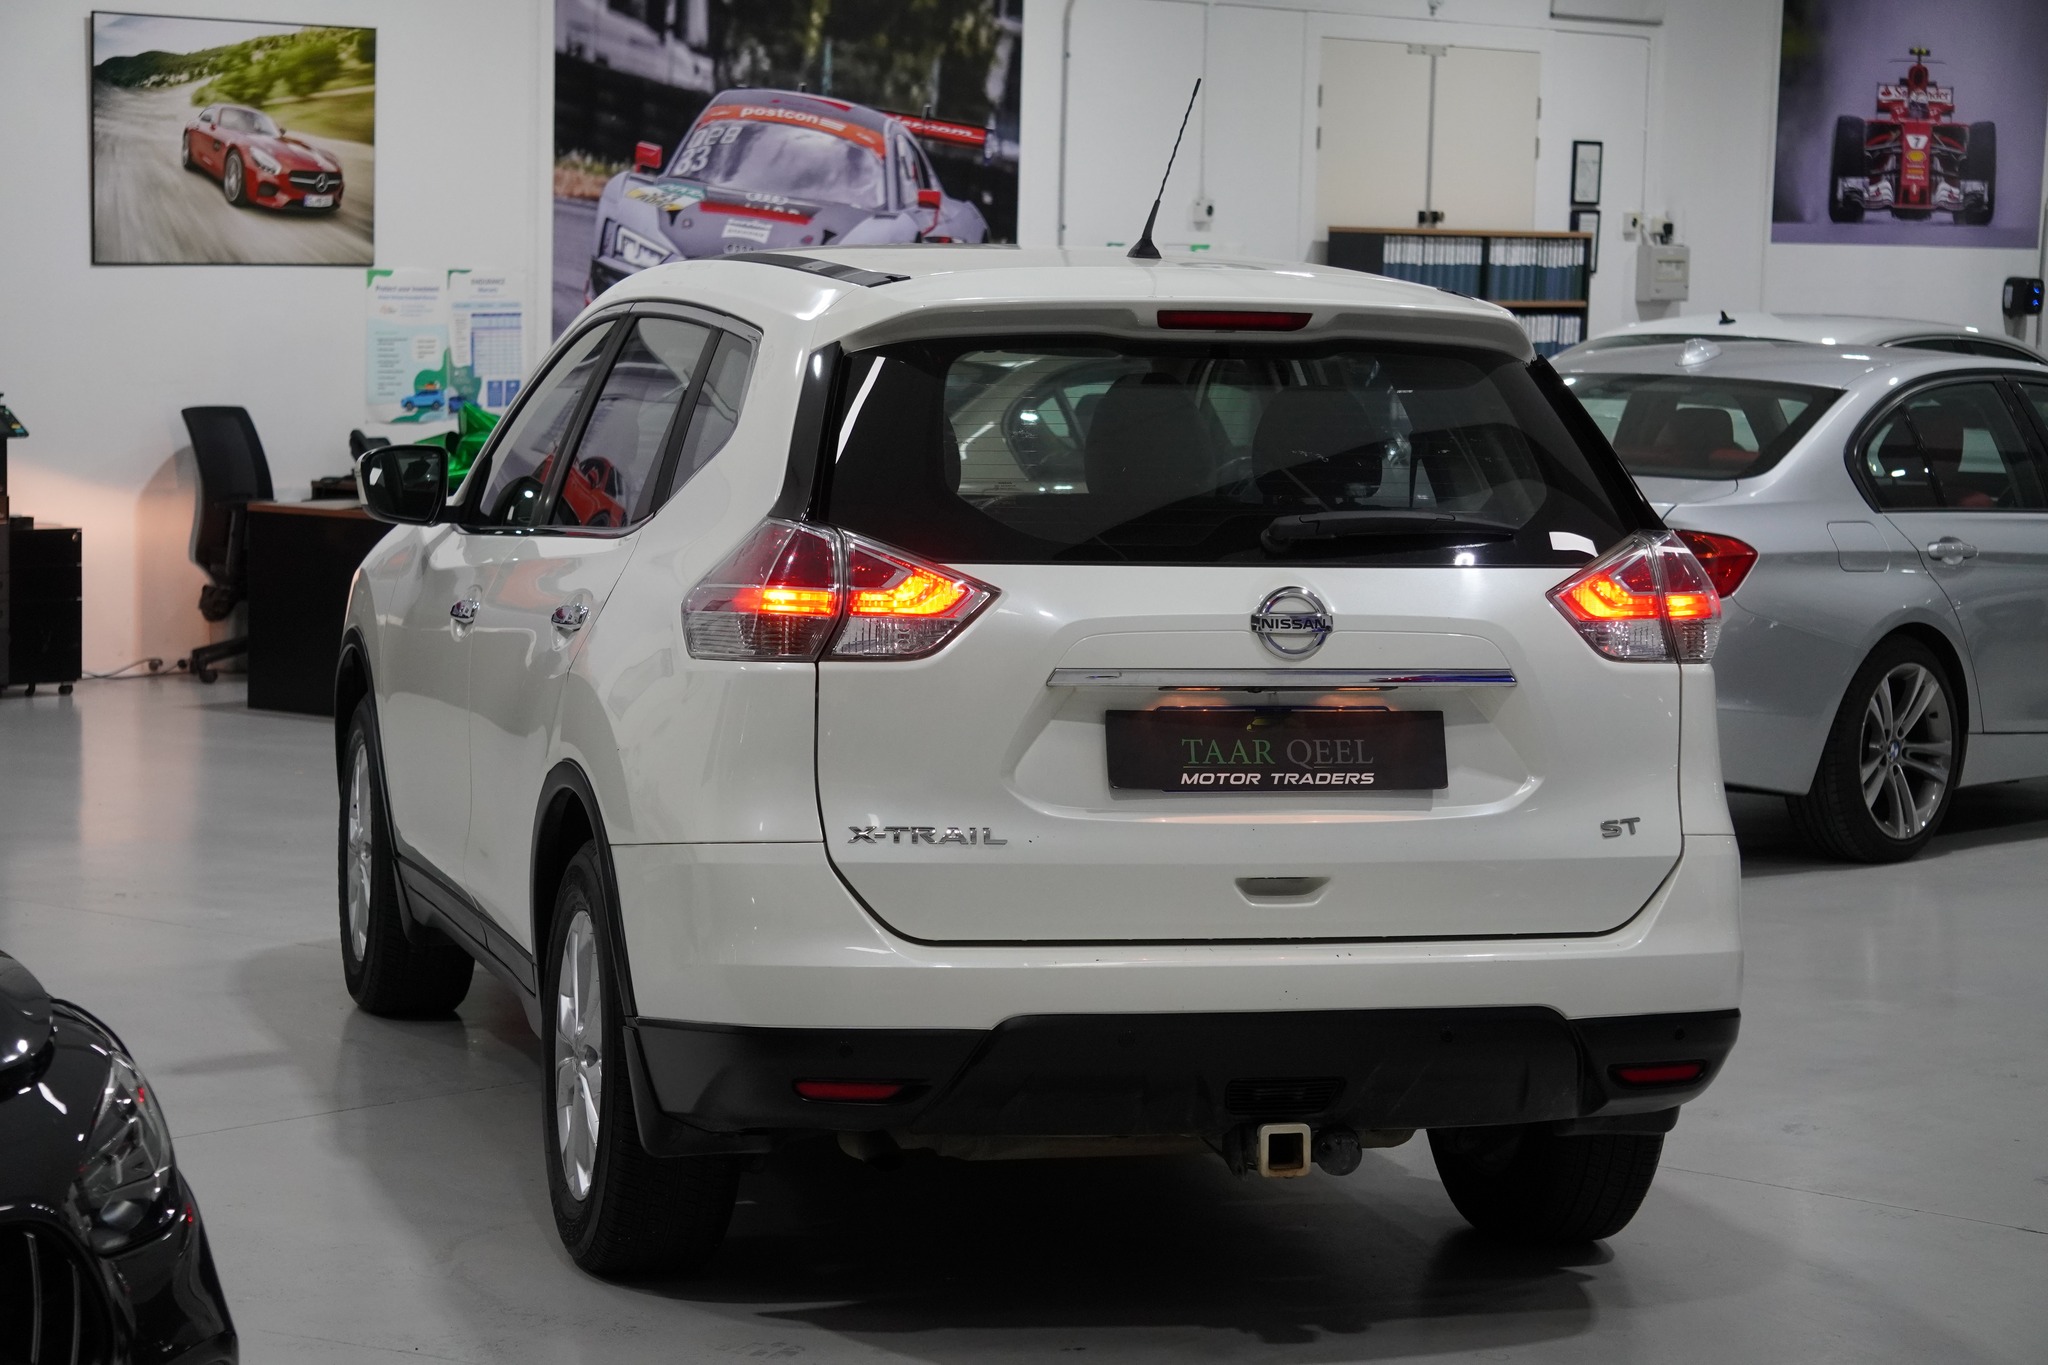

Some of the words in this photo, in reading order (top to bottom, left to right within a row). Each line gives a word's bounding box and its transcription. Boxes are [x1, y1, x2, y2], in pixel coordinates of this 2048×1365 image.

[739, 107, 819, 124] postcon
[1261, 618, 1326, 630] NISSAN
[1181, 738, 1275, 765] TAAR
[1286, 738, 1374, 770] QEEL
[1181, 772, 1261, 785] MOTOR
[1271, 772, 1374, 785] TRADERS
[847, 825, 1008, 845] X-TRAIL
[1599, 816, 1641, 839] ST
